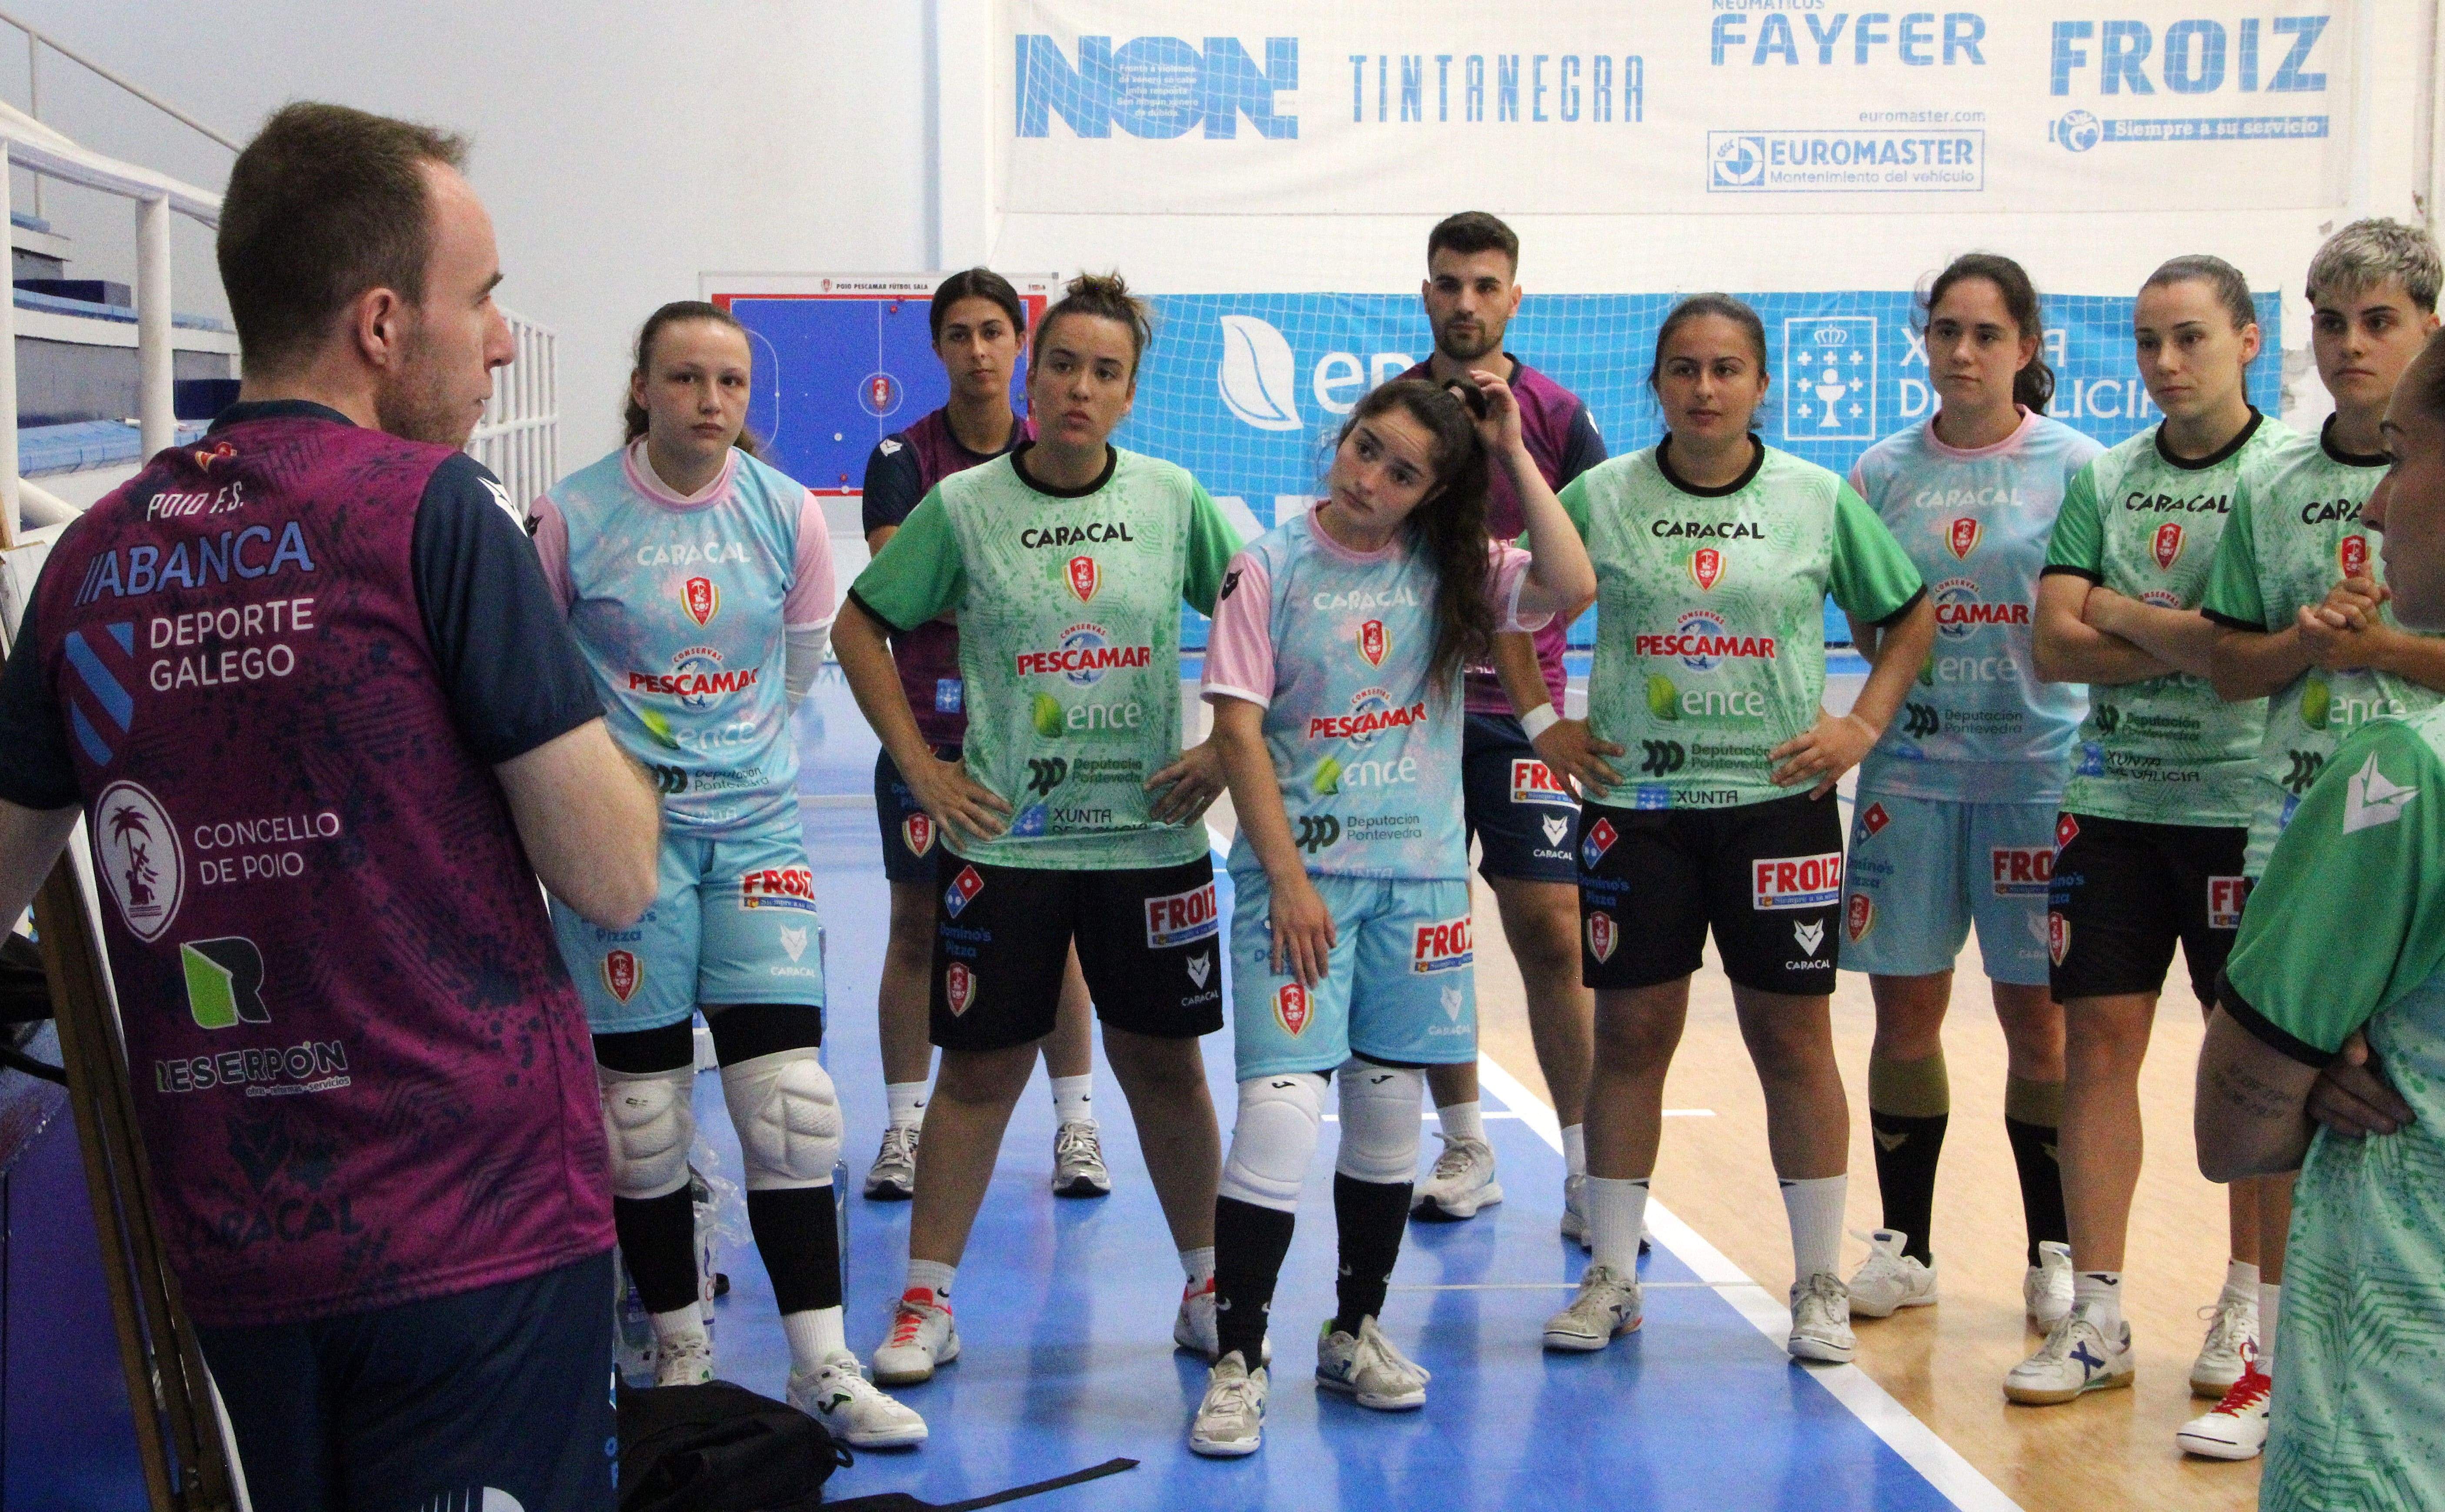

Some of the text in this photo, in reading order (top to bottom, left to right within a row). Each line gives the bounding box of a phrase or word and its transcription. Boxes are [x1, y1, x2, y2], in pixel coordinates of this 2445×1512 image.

[1711, 13, 1986, 66] FAYFER
[2050, 16, 2331, 95] FROIZ
[1016, 35, 1298, 139] NON
[1348, 55, 1644, 123] TINTANEGRA
[1859, 110, 1986, 123] euromaster.com
[2115, 119, 2318, 140] Siempre a su servicio
[1771, 139, 1974, 165] EUROMASTER
[1771, 170, 1974, 183] Mantenimiento del vehículo
[1314, 352, 1415, 414] en
[147, 481, 243, 521] POIO F.S.
[1915, 488, 2023, 507] CARACAL
[2125, 492, 2231, 513] CARACAL
[2302, 499, 2362, 524] CARA
[1021, 522, 1134, 549] CARACAL
[1651, 520, 1765, 540] CARACAL
[87, 522, 315, 604] ABANCA
[637, 543, 752, 565] CARACAL
[1313, 587, 1420, 610] CARACAL
[150, 598, 315, 649] DEPORTE
[1678, 610, 1725, 625] CONSERVAS
[1935, 604, 2030, 624] CAMAR
[1061, 623, 1107, 638] CONSERVAS
[674, 647, 722, 663] CONSERVAS
[1636, 635, 1775, 659] PESCAMAR
[150, 644, 294, 691] GALEGO
[1017, 646, 1151, 675] PESCAMAR
[1939, 655, 2018, 682] ence
[1682, 689, 1764, 716] ence
[1067, 703, 1143, 729] ence
[676, 722, 757, 749] ence
[1691, 744, 1770, 758] Deputación
[1344, 756, 1418, 786] ence
[1677, 790, 1738, 804] XUNTA
[1054, 808, 1112, 823] XUNTA
[194, 813, 340, 849] CONCELLO
[1348, 826, 1422, 840] Pontevedra
[1533, 849, 1573, 860] CARACAL
[200, 852, 304, 885] DE POIO
[1758, 857, 1840, 893] FROIZ
[743, 869, 815, 900] FROIZ
[1150, 885, 1217, 932] FROIZ
[597, 930, 642, 943] Pizza
[771, 966, 815, 977] CARACAL
[1785, 959, 1830, 970] CARACAL
[1181, 990, 1219, 1006] CARACAL
